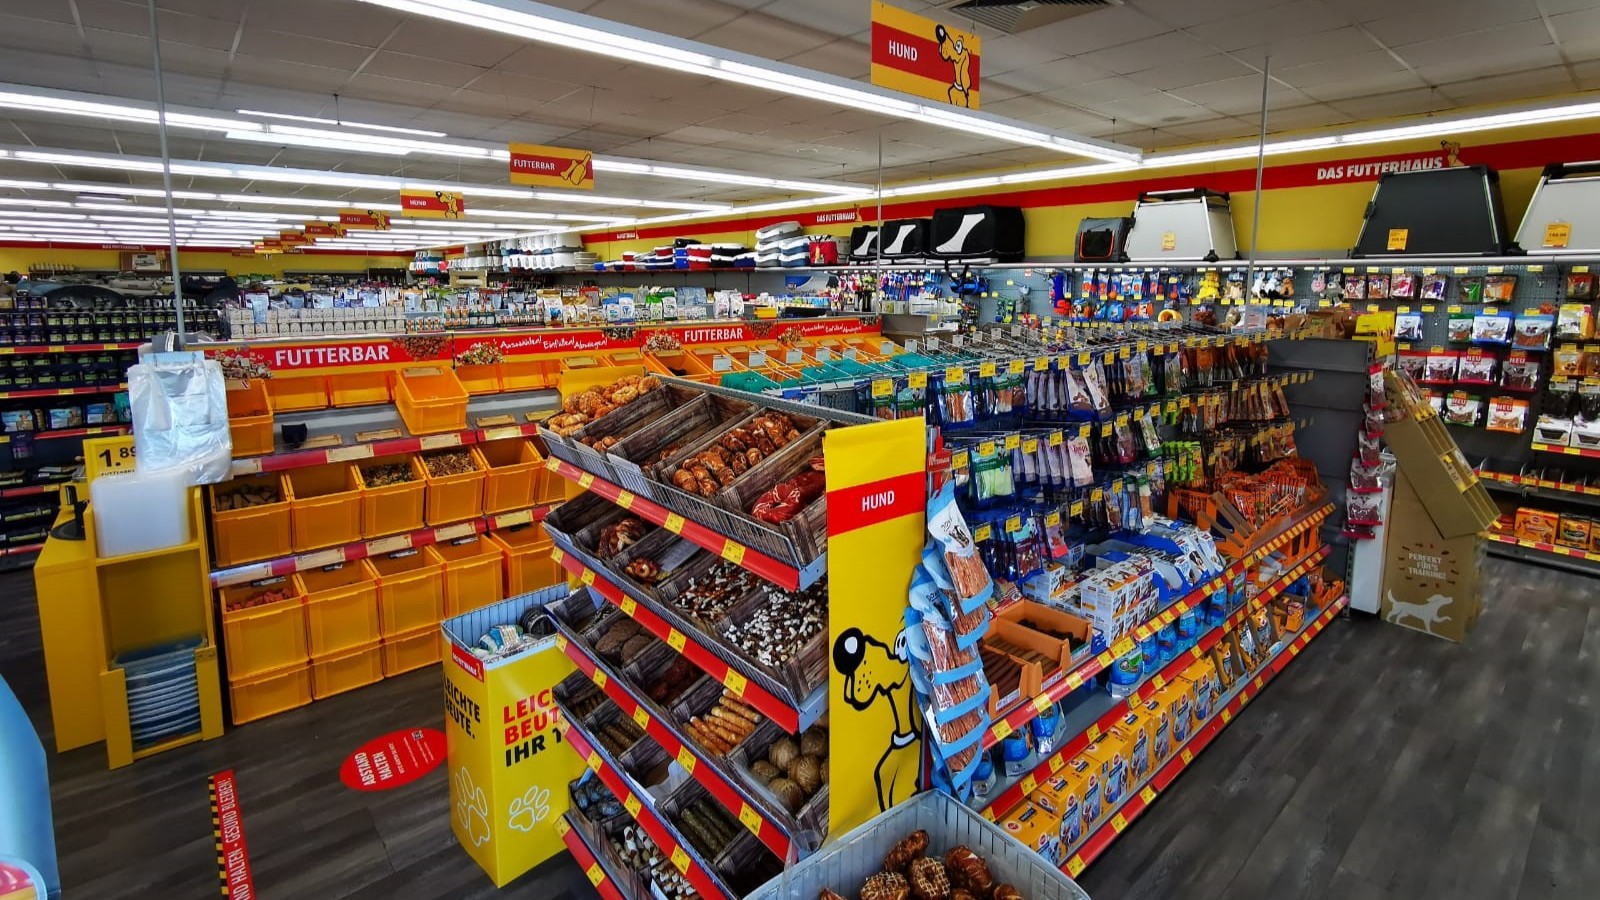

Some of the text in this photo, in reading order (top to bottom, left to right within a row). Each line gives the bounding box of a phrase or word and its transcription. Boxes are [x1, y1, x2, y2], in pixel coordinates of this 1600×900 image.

[888, 40, 918, 62] HUND
[513, 159, 555, 171] FUTTERBAR
[1317, 157, 1443, 180] DAS FUTTERHAUS
[410, 199, 427, 207] HUND
[684, 327, 744, 343] FUTTERBAR
[275, 345, 390, 366] FUTTERBAR
[861, 490, 896, 512] HUND
[1408, 552, 1441, 564] PERFEKT
[444, 672, 481, 723] LEICHTE
[503, 689, 555, 725] LEIC
[445, 693, 476, 740] BEUTE.
[372, 751, 393, 781] HALTEN
[505, 734, 546, 768] IHR
[354, 752, 377, 786] ABSTAND
[217, 777, 236, 812] BLEIBEN!
[222, 810, 241, 843] GESUND
[228, 847, 248, 885] HALTEN
